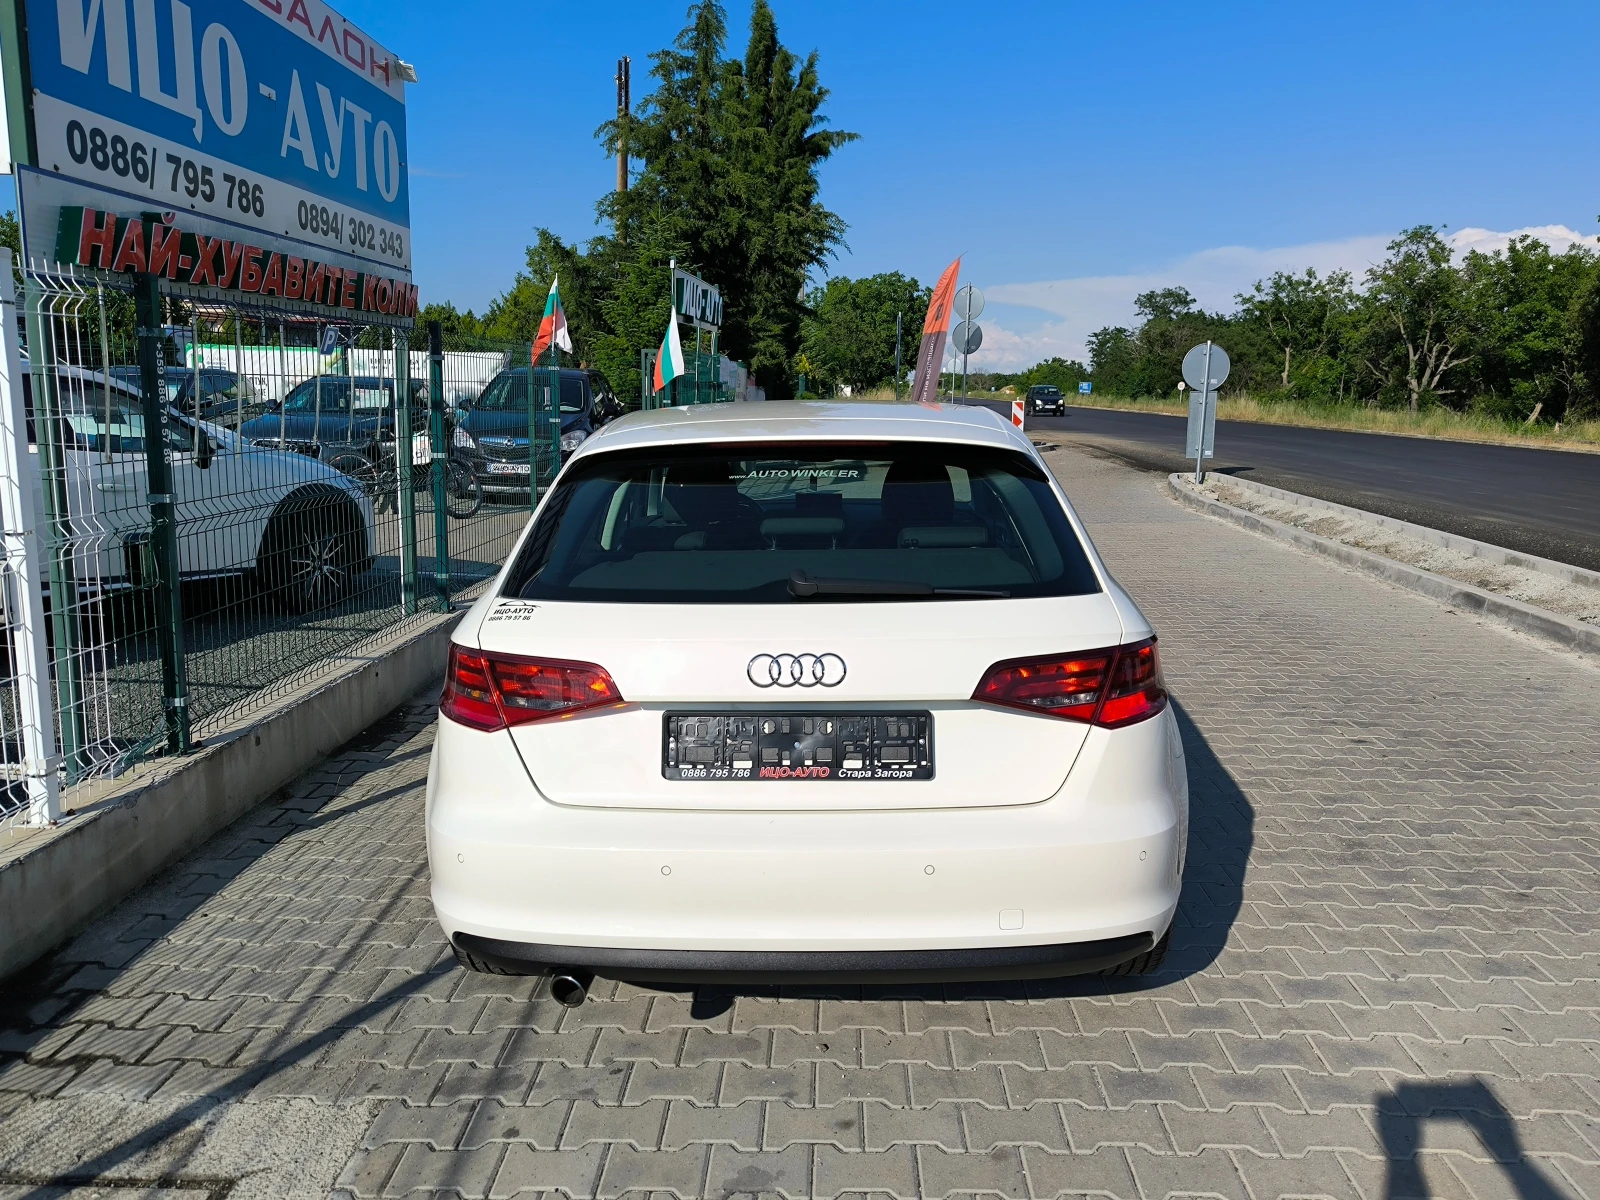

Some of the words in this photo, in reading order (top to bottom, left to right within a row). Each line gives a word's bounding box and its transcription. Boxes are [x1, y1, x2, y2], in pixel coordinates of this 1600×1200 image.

[66, 119, 157, 190] 0886/
[166, 153, 216, 202] 795
[223, 173, 265, 218] 786
[297, 199, 344, 245] 0894/
[348, 217, 376, 251] 302
[379, 229, 404, 259] 343
[78, 206, 357, 310] НАЙ-ХУБАВИТЕ
[361, 272, 419, 319] КОЛИ
[681, 278, 723, 326] ИЦО-АУТО
[158, 379, 166, 403] 886
[160, 407, 168, 423] 79
[162, 428, 170, 443] 57
[164, 448, 172, 464] 86
[681, 769, 707, 778] 0886
[710, 769, 729, 777] 795
[731, 769, 751, 777] 786
[759, 766, 830, 778] ИЦО-АУТО
[838, 769, 871, 778] Стара
[874, 769, 913, 778] Загора
